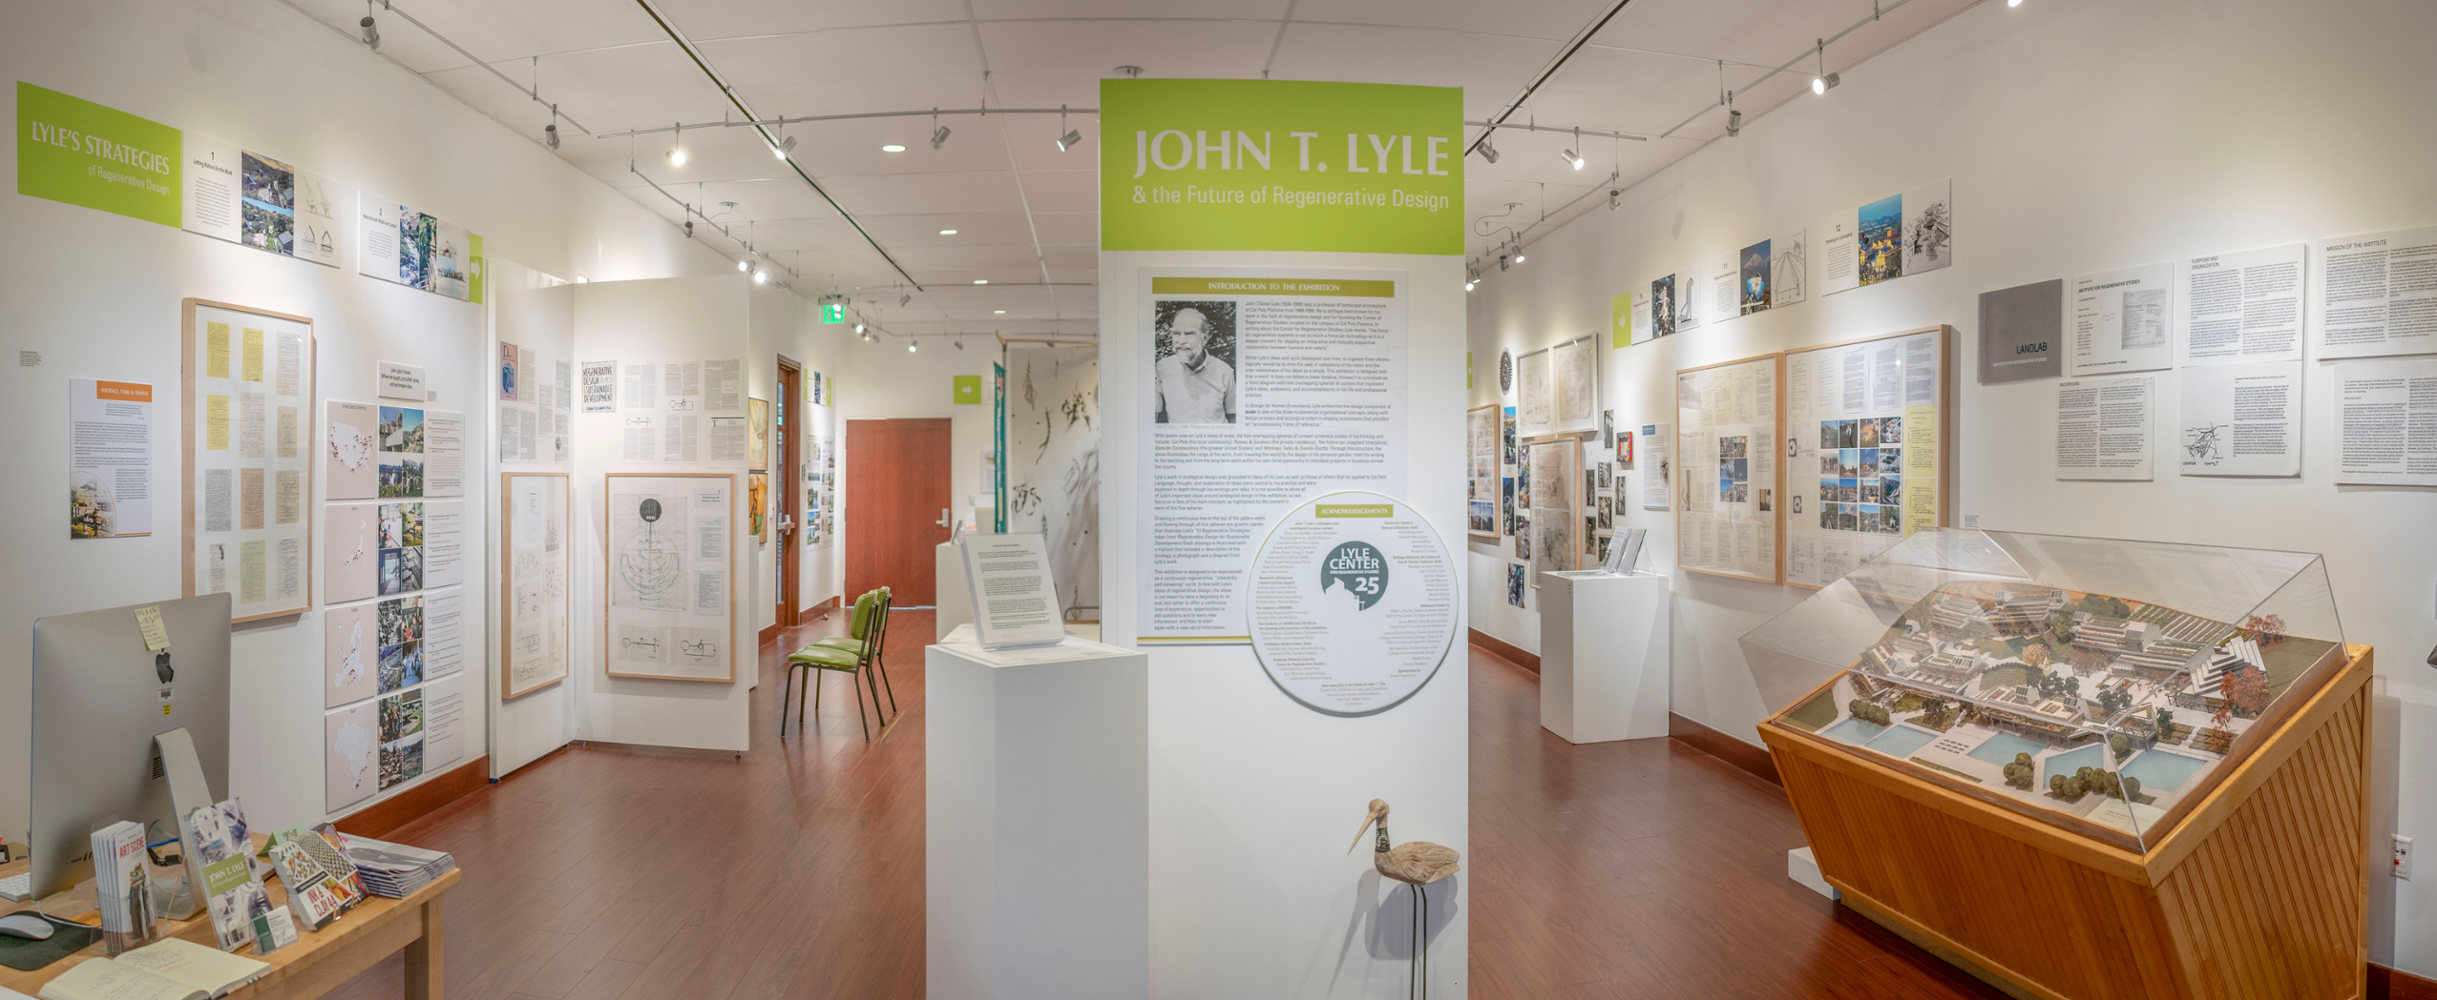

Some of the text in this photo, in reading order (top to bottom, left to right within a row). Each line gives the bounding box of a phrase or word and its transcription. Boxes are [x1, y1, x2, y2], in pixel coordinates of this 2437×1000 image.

[32, 120, 170, 175] LYLE'S STRATEGIES
[211, 151, 215, 160] 1
[1132, 129, 1449, 179] JOHN T. LYLE
[193, 158, 204, 168] Letting
[87, 165, 170, 196] of Regenerative Design
[1132, 185, 1449, 213] & the Future of Regenerative Design
[1836, 224, 1841, 232] 12
[2326, 244, 2345, 252] MISSION
[2363, 239, 2387, 248] INSTITUTE
[2191, 262, 2220, 270] ORGANIZATION
[1208, 282, 1340, 292] INTRODUCTION TO THE EXHIBITION
[2078, 285, 2094, 293] INSTITUTE
[2101, 281, 2125, 289] REGENERATIVE
[2016, 341, 2048, 355] LANDLAB
[584, 376, 599, 385] DESIGN
[586, 384, 613, 394] SUSTAINABLE
[584, 394, 612, 403] DEVELOPMENT
[1341, 548, 1370, 559] LYLE
[1329, 558, 1380, 570] CENTER
[1355, 577, 1380, 595] 25
[120, 836, 145, 859] ART SCENE
[209, 868, 226, 884] JOHN
[231, 861, 245, 873] LYLE
[307, 885, 324, 904] INK &
[314, 894, 337, 917] CLAY 44
